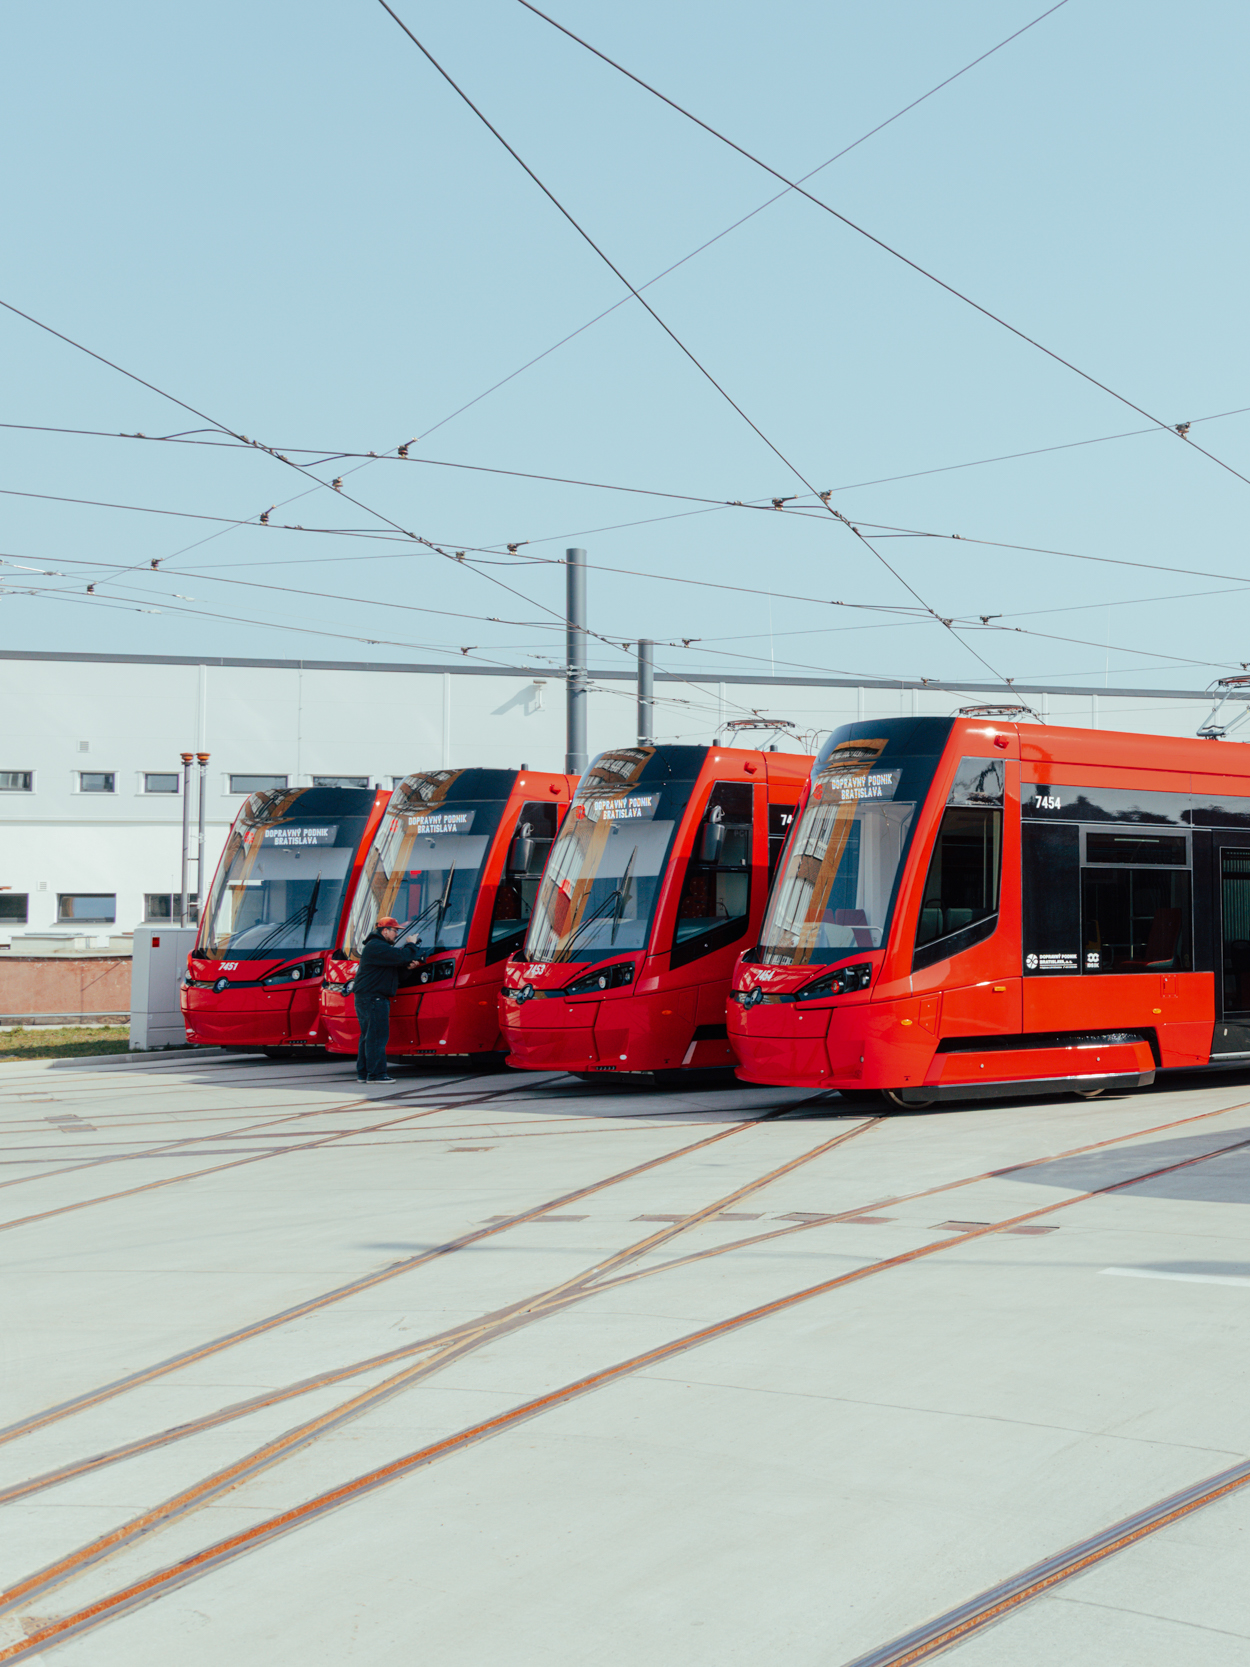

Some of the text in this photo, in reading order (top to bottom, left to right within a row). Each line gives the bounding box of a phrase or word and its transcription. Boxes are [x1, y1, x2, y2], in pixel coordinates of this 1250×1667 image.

[868, 773, 893, 786] PODNIK
[841, 786, 883, 800] BRATISLAVA
[1035, 795, 1061, 810] 7454
[603, 808, 642, 820] BRATISLAVA
[303, 828, 329, 837] PODNIK
[417, 824, 457, 834] BRATISLAVA
[274, 837, 318, 846] BRATISLAVA
[218, 962, 239, 971] 7451
[526, 964, 546, 975] 7453
